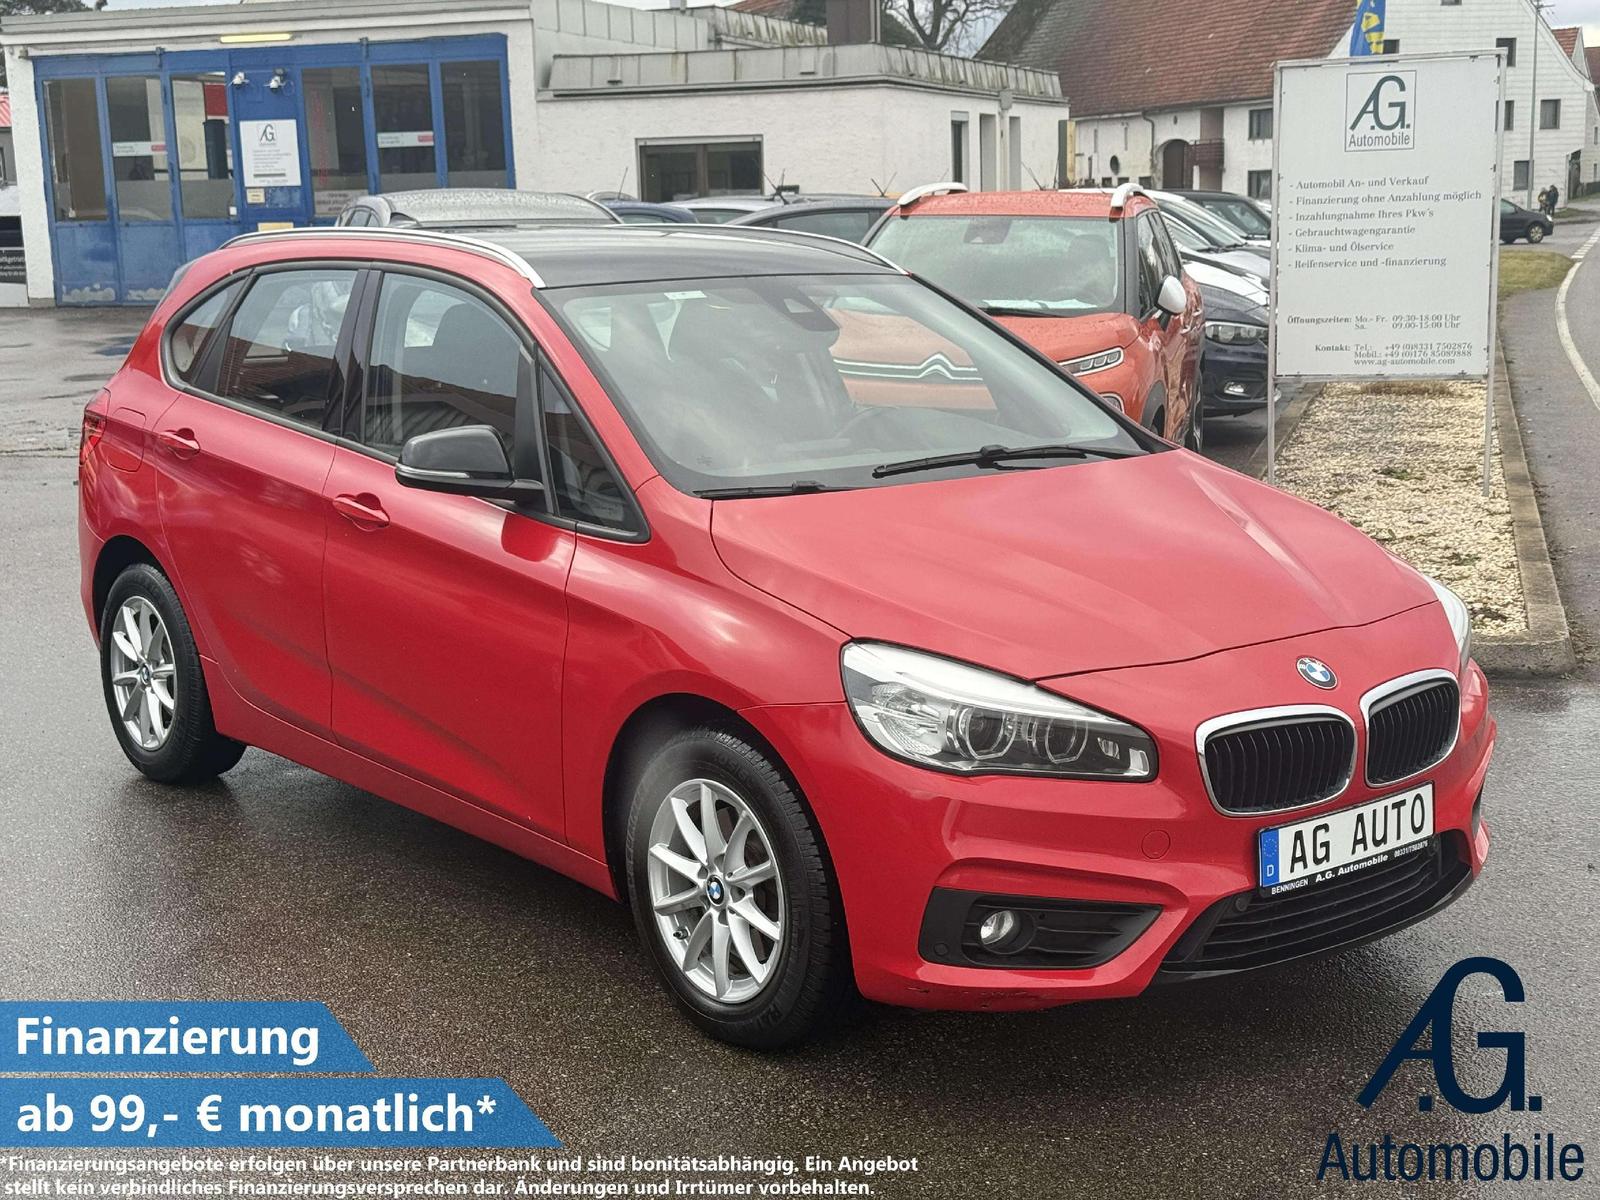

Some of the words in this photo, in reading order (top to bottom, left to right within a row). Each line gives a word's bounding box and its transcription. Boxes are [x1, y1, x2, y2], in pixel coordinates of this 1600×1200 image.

[1348, 132, 1410, 148] Automobile
[1296, 179, 1345, 190] Automobil
[1347, 179, 1365, 188] An-
[1368, 177, 1386, 187] und
[1389, 176, 1429, 187] Verkauf
[1296, 195, 1359, 206] Finanzierung
[1361, 194, 1385, 203] ohne
[1388, 192, 1440, 203] Anzahlung
[1443, 190, 1482, 202] möglich
[1296, 211, 1375, 222] Inzahlungnahme
[1378, 209, 1402, 219] Ihres
[1295, 225, 1416, 238] Gebrauchtwagengarantie
[1295, 244, 1327, 253] Klima-
[1329, 243, 1347, 252] und
[1350, 241, 1394, 251] Ölservice
[1295, 258, 1358, 269] Reifenservice
[1360, 258, 1378, 267] und
[1381, 257, 1447, 267] -finanzierung
[1287, 315, 1352, 325] Öffnungszeiten:
[1444, 313, 1461, 321] Uhr
[1444, 321, 1460, 329] Uhr
[1315, 344, 1351, 352] Kontakt:
[1353, 358, 1455, 366] www.ag-automobile.com
[1289, 822, 1331, 874] AG
[1351, 793, 1426, 856] AUTO
[1266, 864, 1274, 877] D
[1271, 878, 1309, 895] BENNINGEN
[1315, 870, 1336, 883] A.G.
[1337, 853, 1389, 876] Automobile
